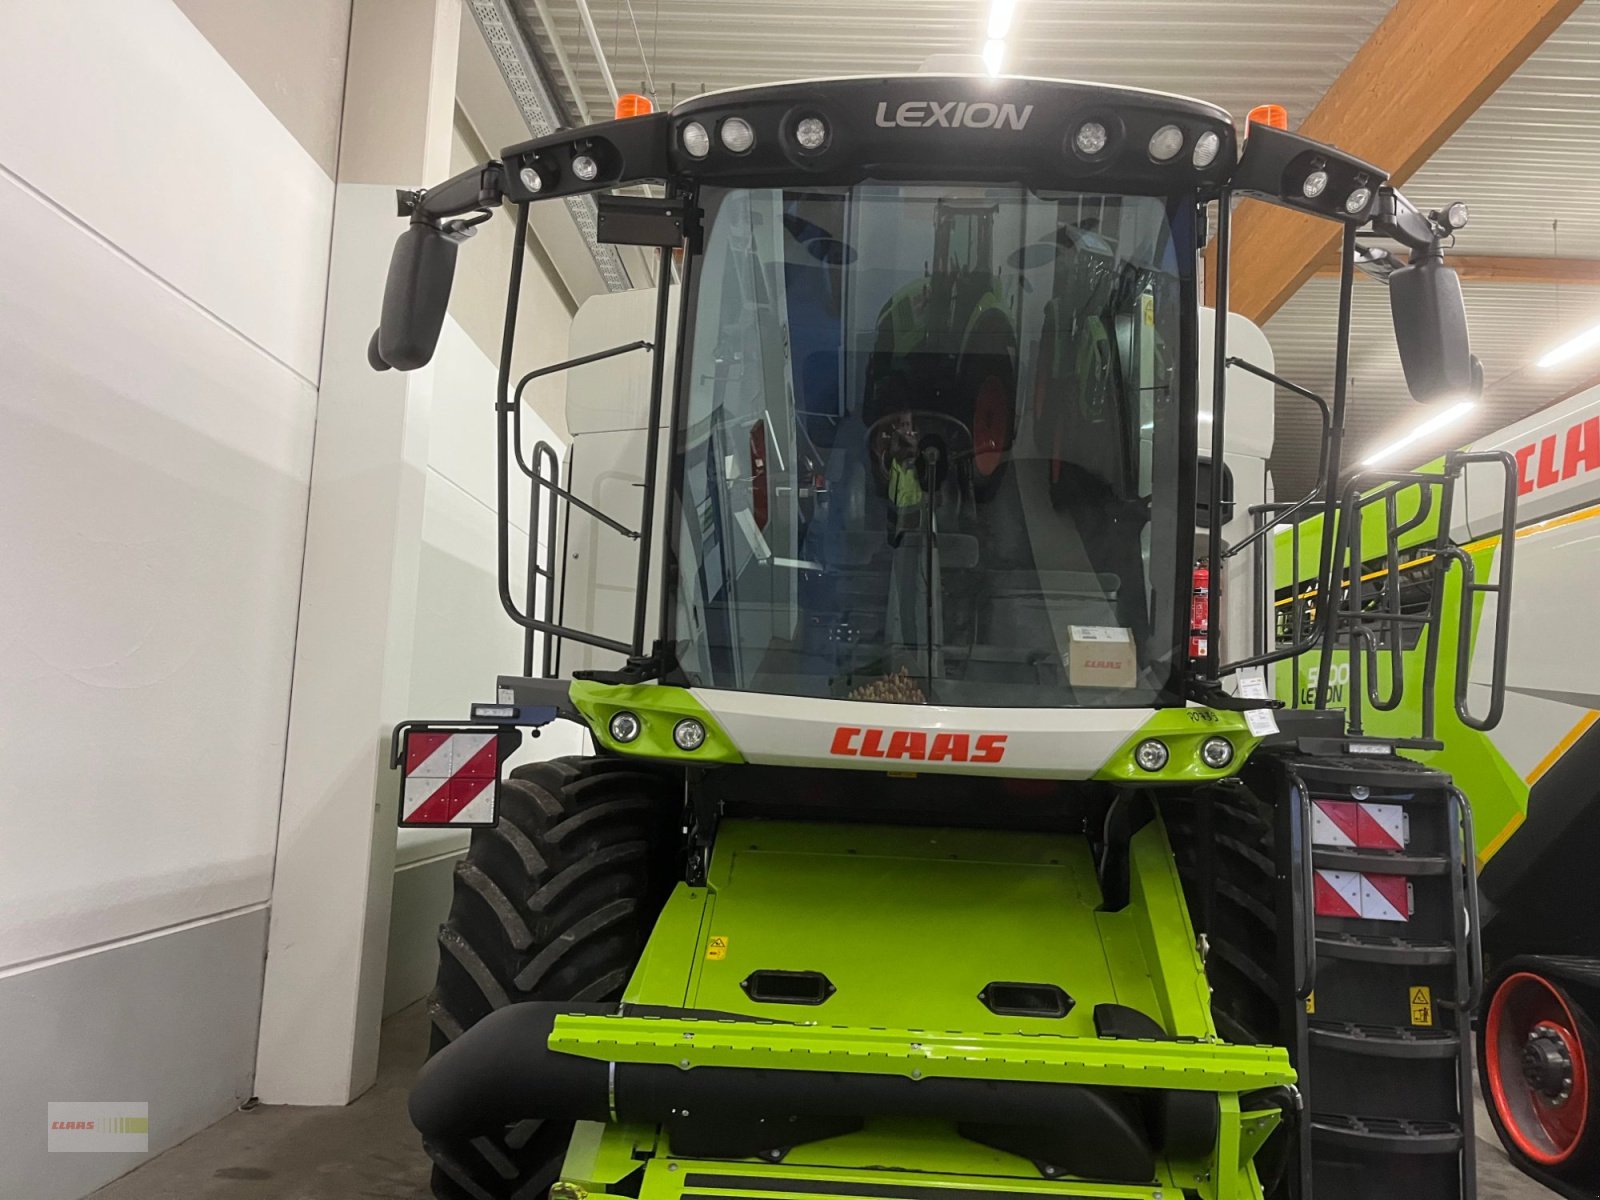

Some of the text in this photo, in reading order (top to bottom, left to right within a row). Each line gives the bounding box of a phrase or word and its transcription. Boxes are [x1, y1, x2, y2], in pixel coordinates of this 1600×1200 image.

[875, 101, 1034, 130] LEXION
[1084, 660, 1121, 669] CLAAS
[1301, 685, 1343, 705] LEON
[830, 727, 1008, 763] CLAAS
